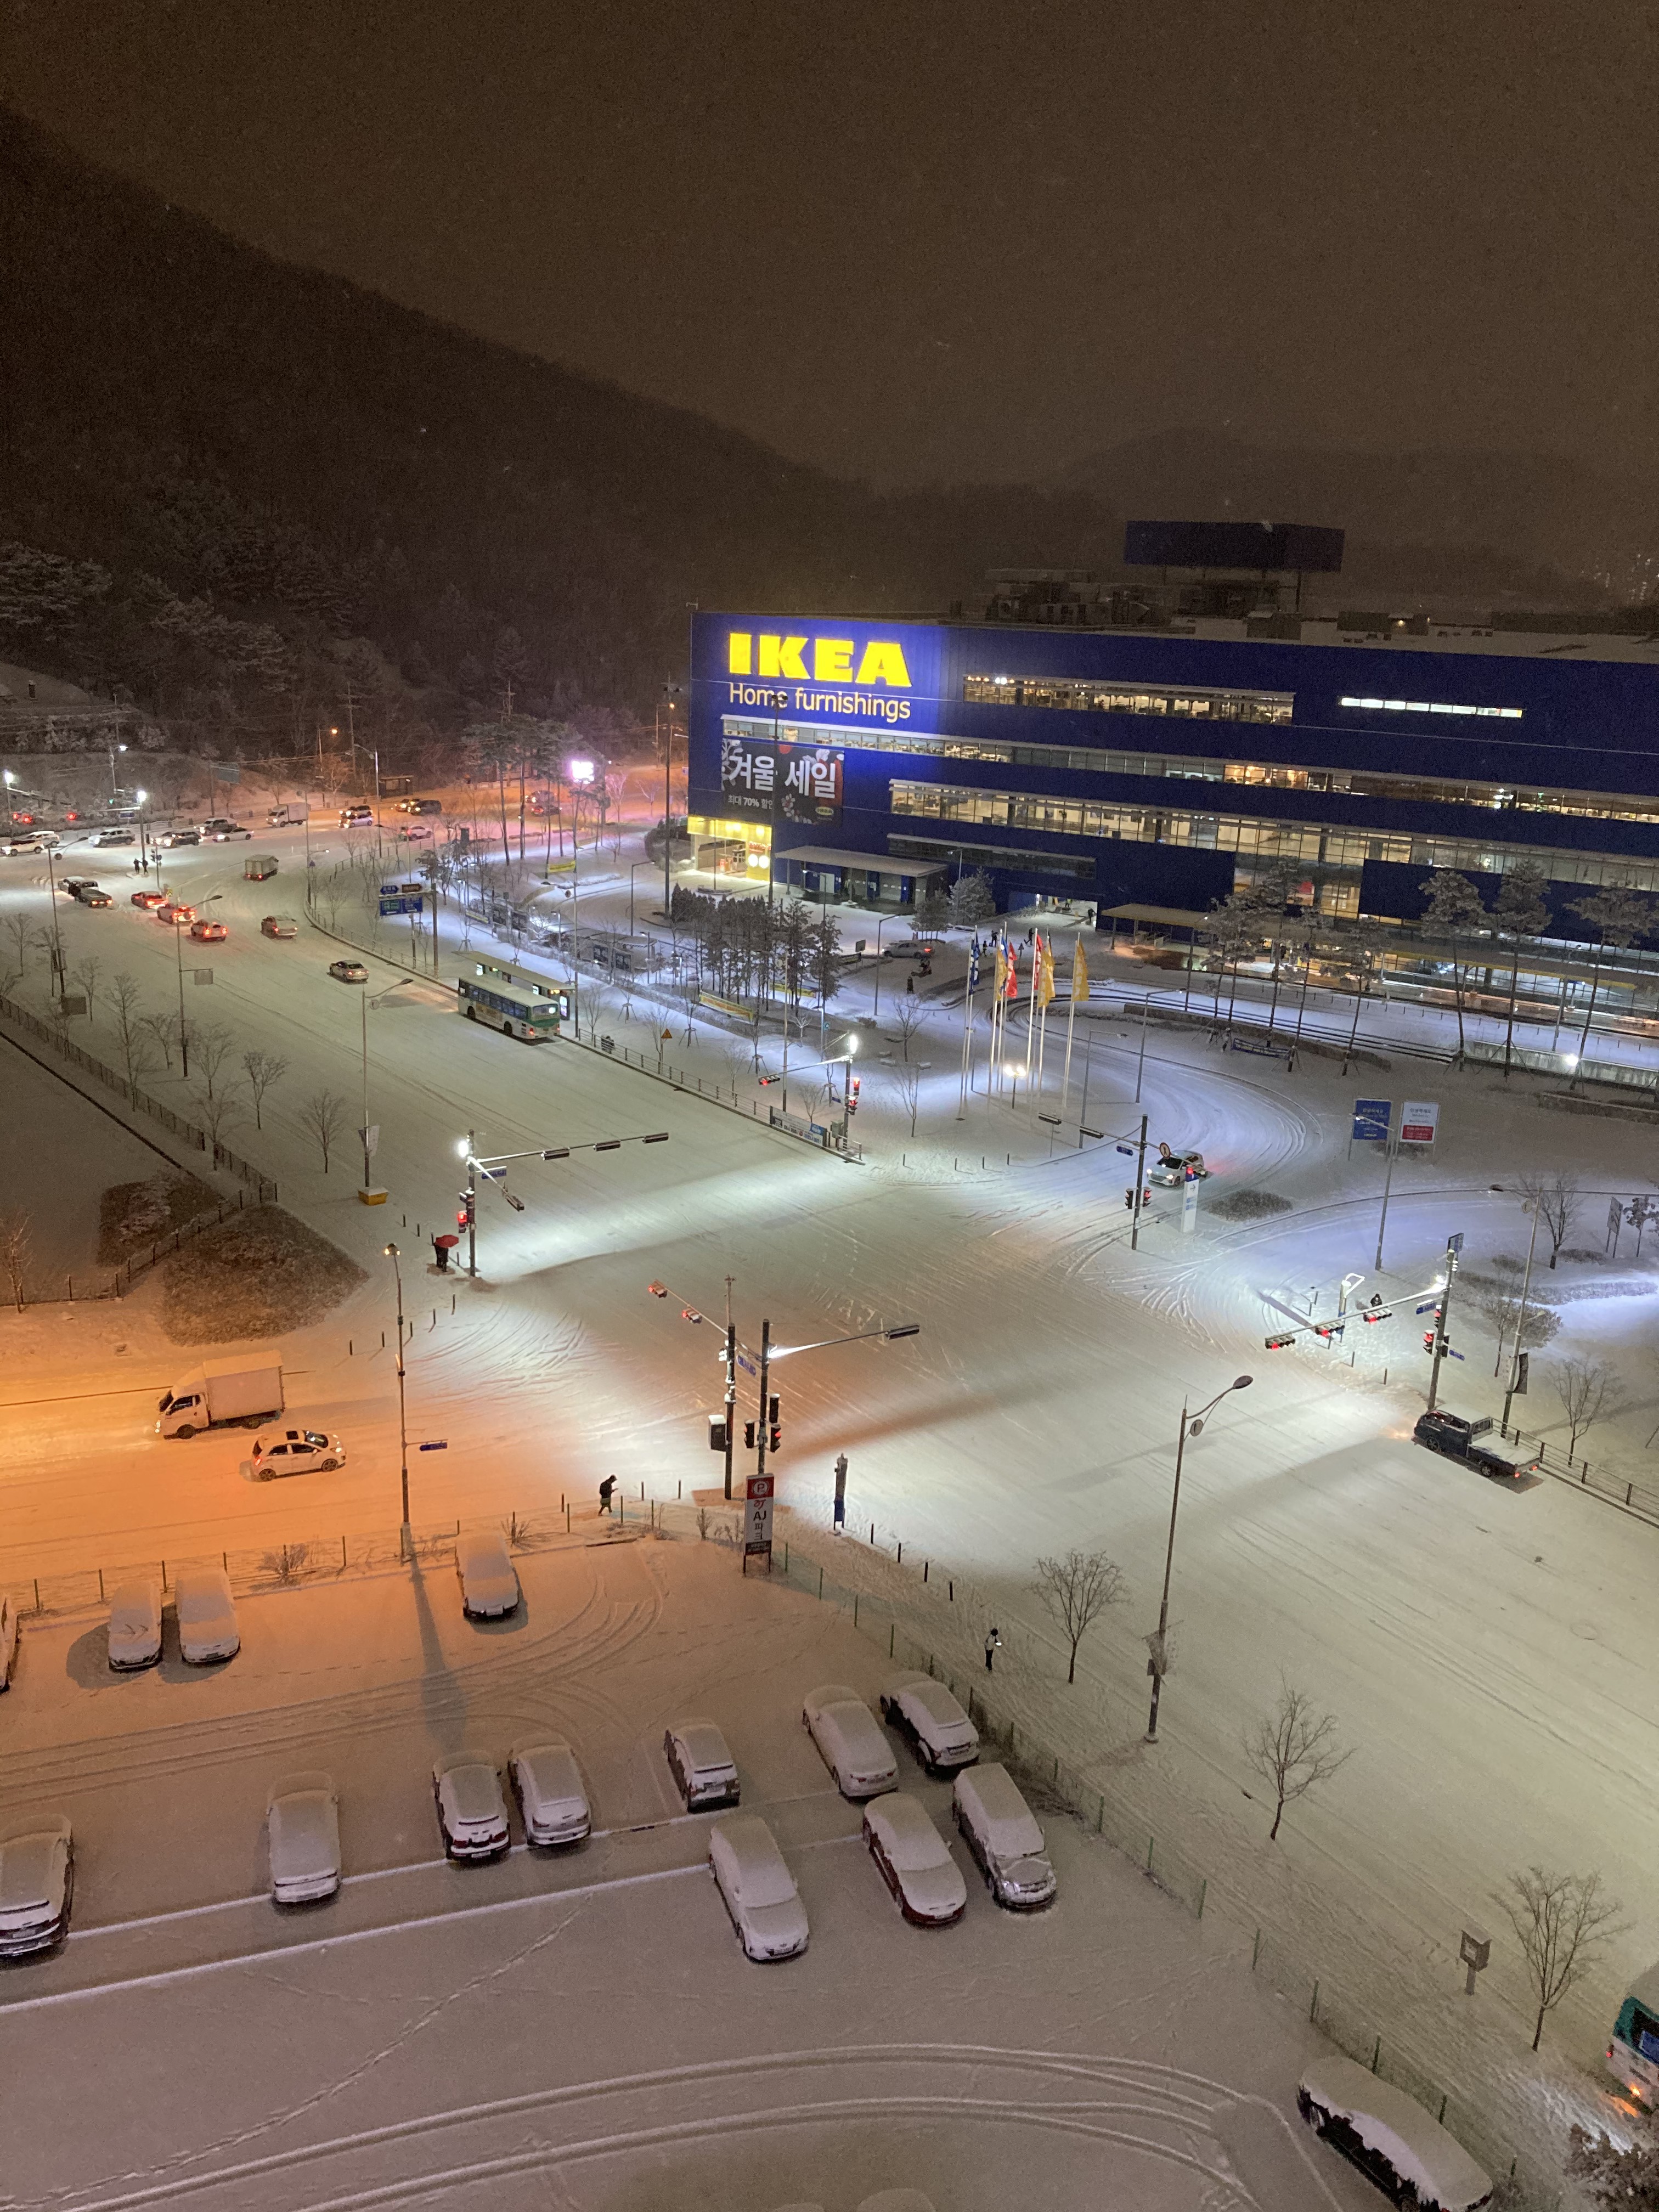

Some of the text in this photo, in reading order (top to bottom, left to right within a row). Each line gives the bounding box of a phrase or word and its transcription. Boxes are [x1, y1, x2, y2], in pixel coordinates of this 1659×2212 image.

[729, 633, 912, 687] IKEA
[730, 682, 911, 724] Home furnishings
[729, 754, 836, 799] 겨울 세일
[728, 794, 742, 806] 최대
[743, 797, 760, 807] 70%
[753, 1510, 767, 1521] AJ
